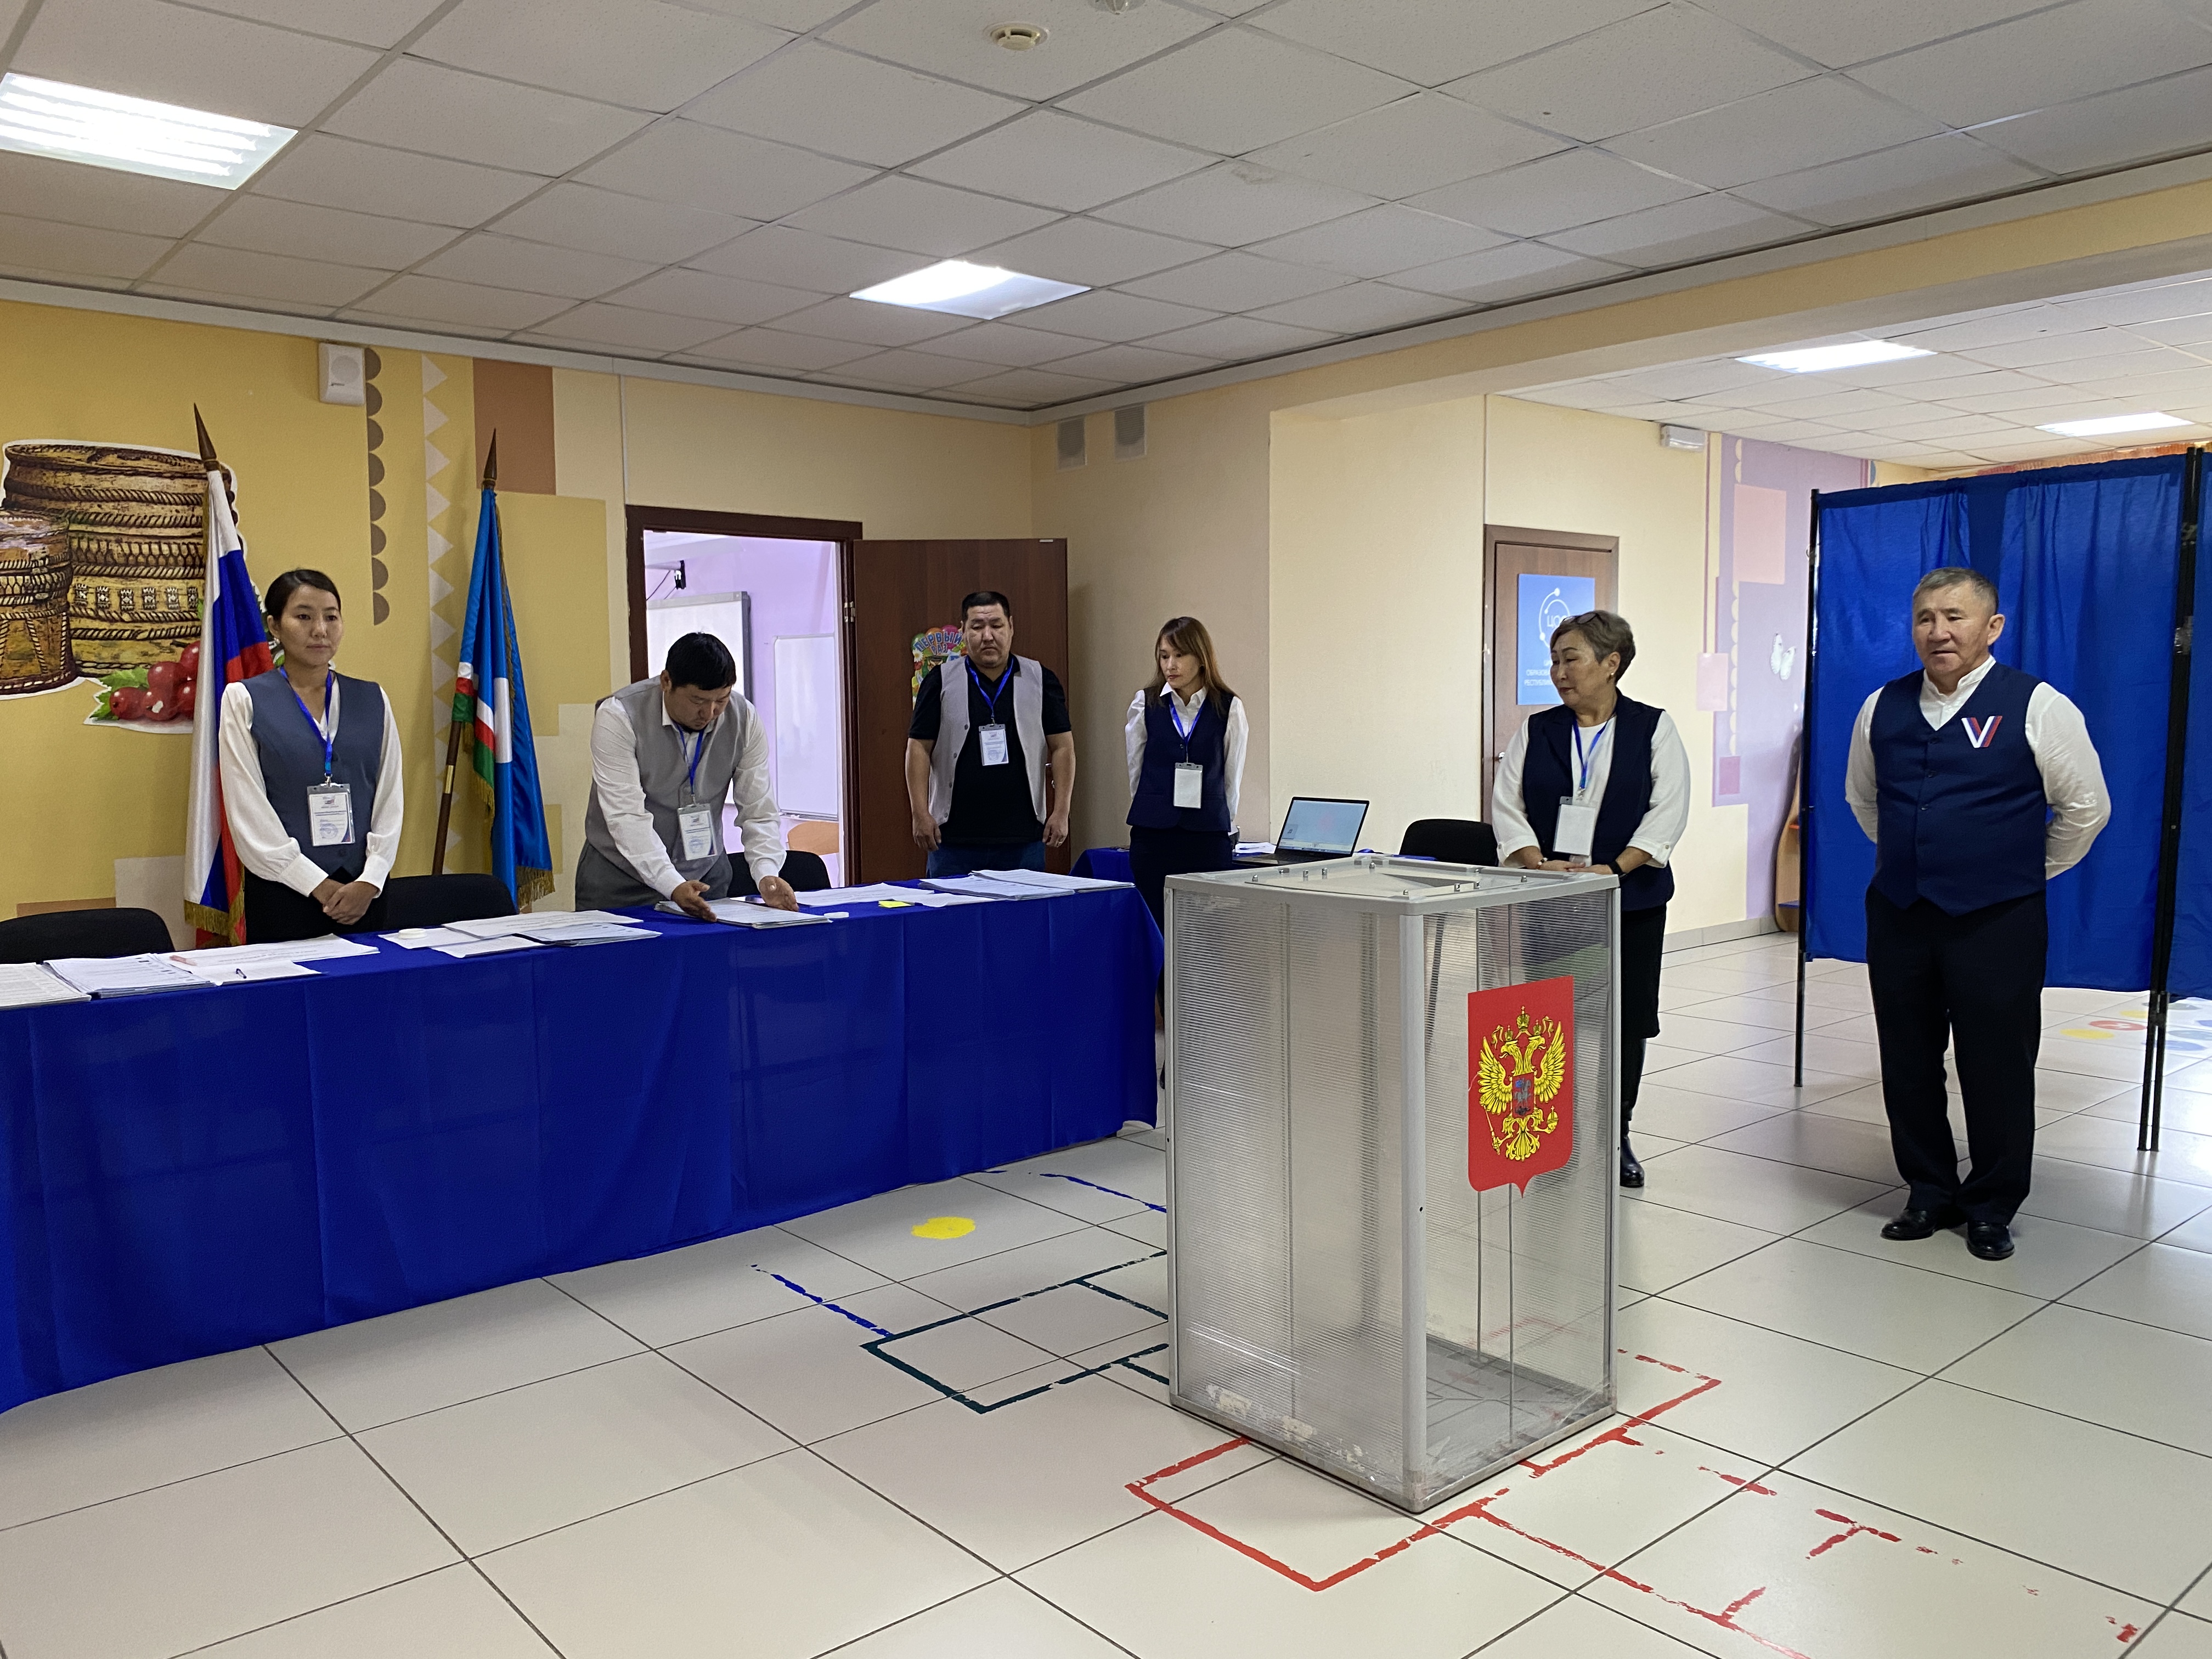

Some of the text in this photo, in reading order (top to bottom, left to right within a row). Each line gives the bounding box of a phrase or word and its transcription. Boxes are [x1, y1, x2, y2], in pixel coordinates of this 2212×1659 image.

[914, 631, 963, 652] ПЕРВЫЙ
[930, 642, 948, 655] РАЗ
[1961, 715, 2003, 748] V
